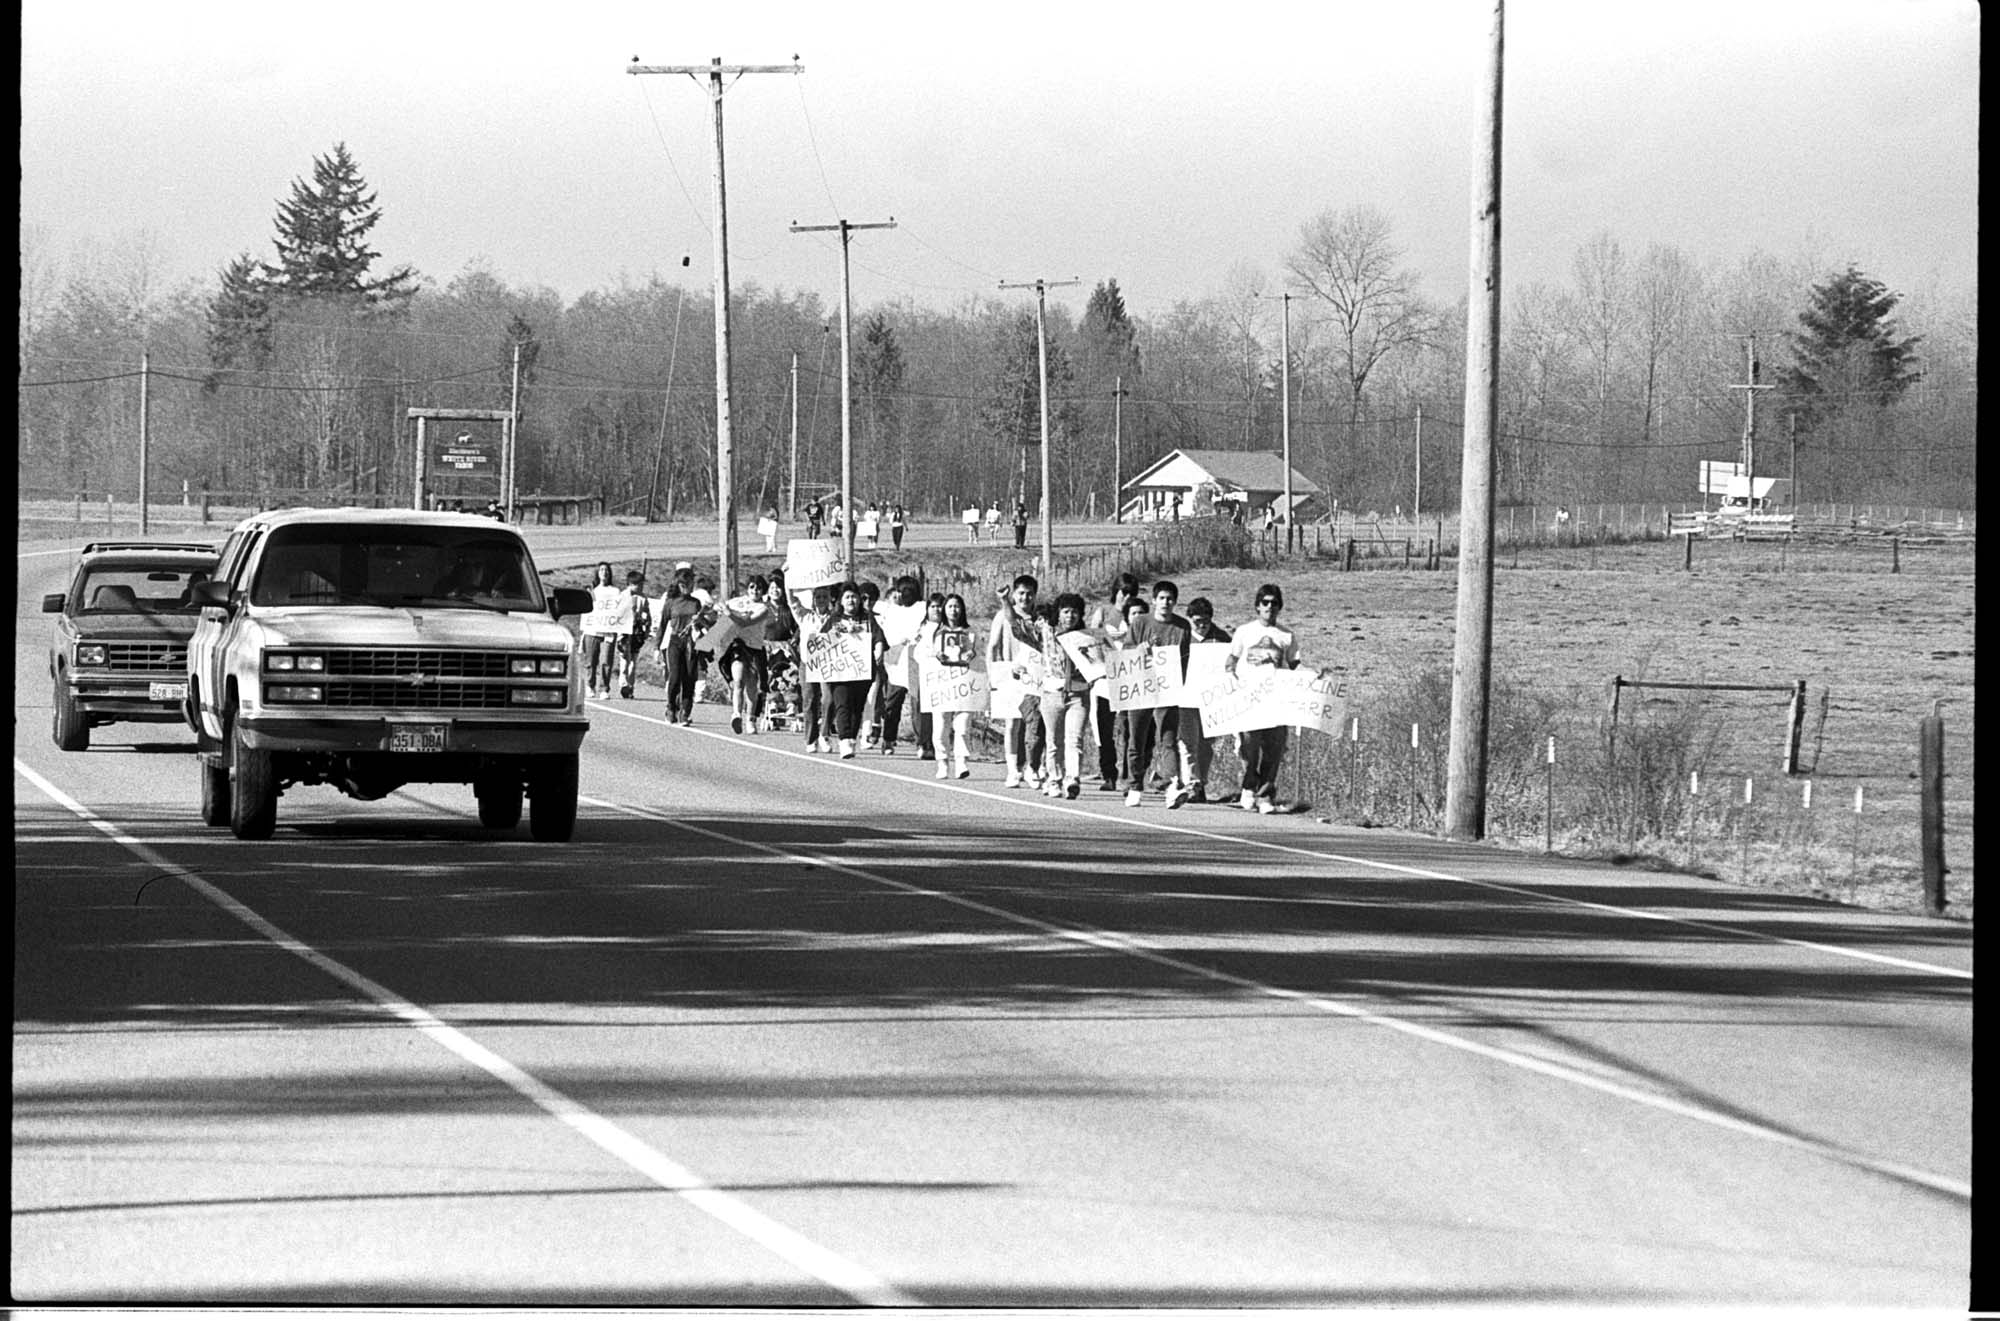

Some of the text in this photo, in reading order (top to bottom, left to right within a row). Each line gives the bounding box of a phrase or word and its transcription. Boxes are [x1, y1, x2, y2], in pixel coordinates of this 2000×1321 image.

[596, 598, 622, 610] OEY
[806, 633, 832, 655] BEN
[807, 639, 850, 672] WHITE
[820, 651, 863, 680] EAGLE
[926, 666, 971, 687] FRED
[1108, 651, 1167, 680] JAMES
[931, 678, 981, 708] ENICK
[1119, 676, 1169, 701] BARR
